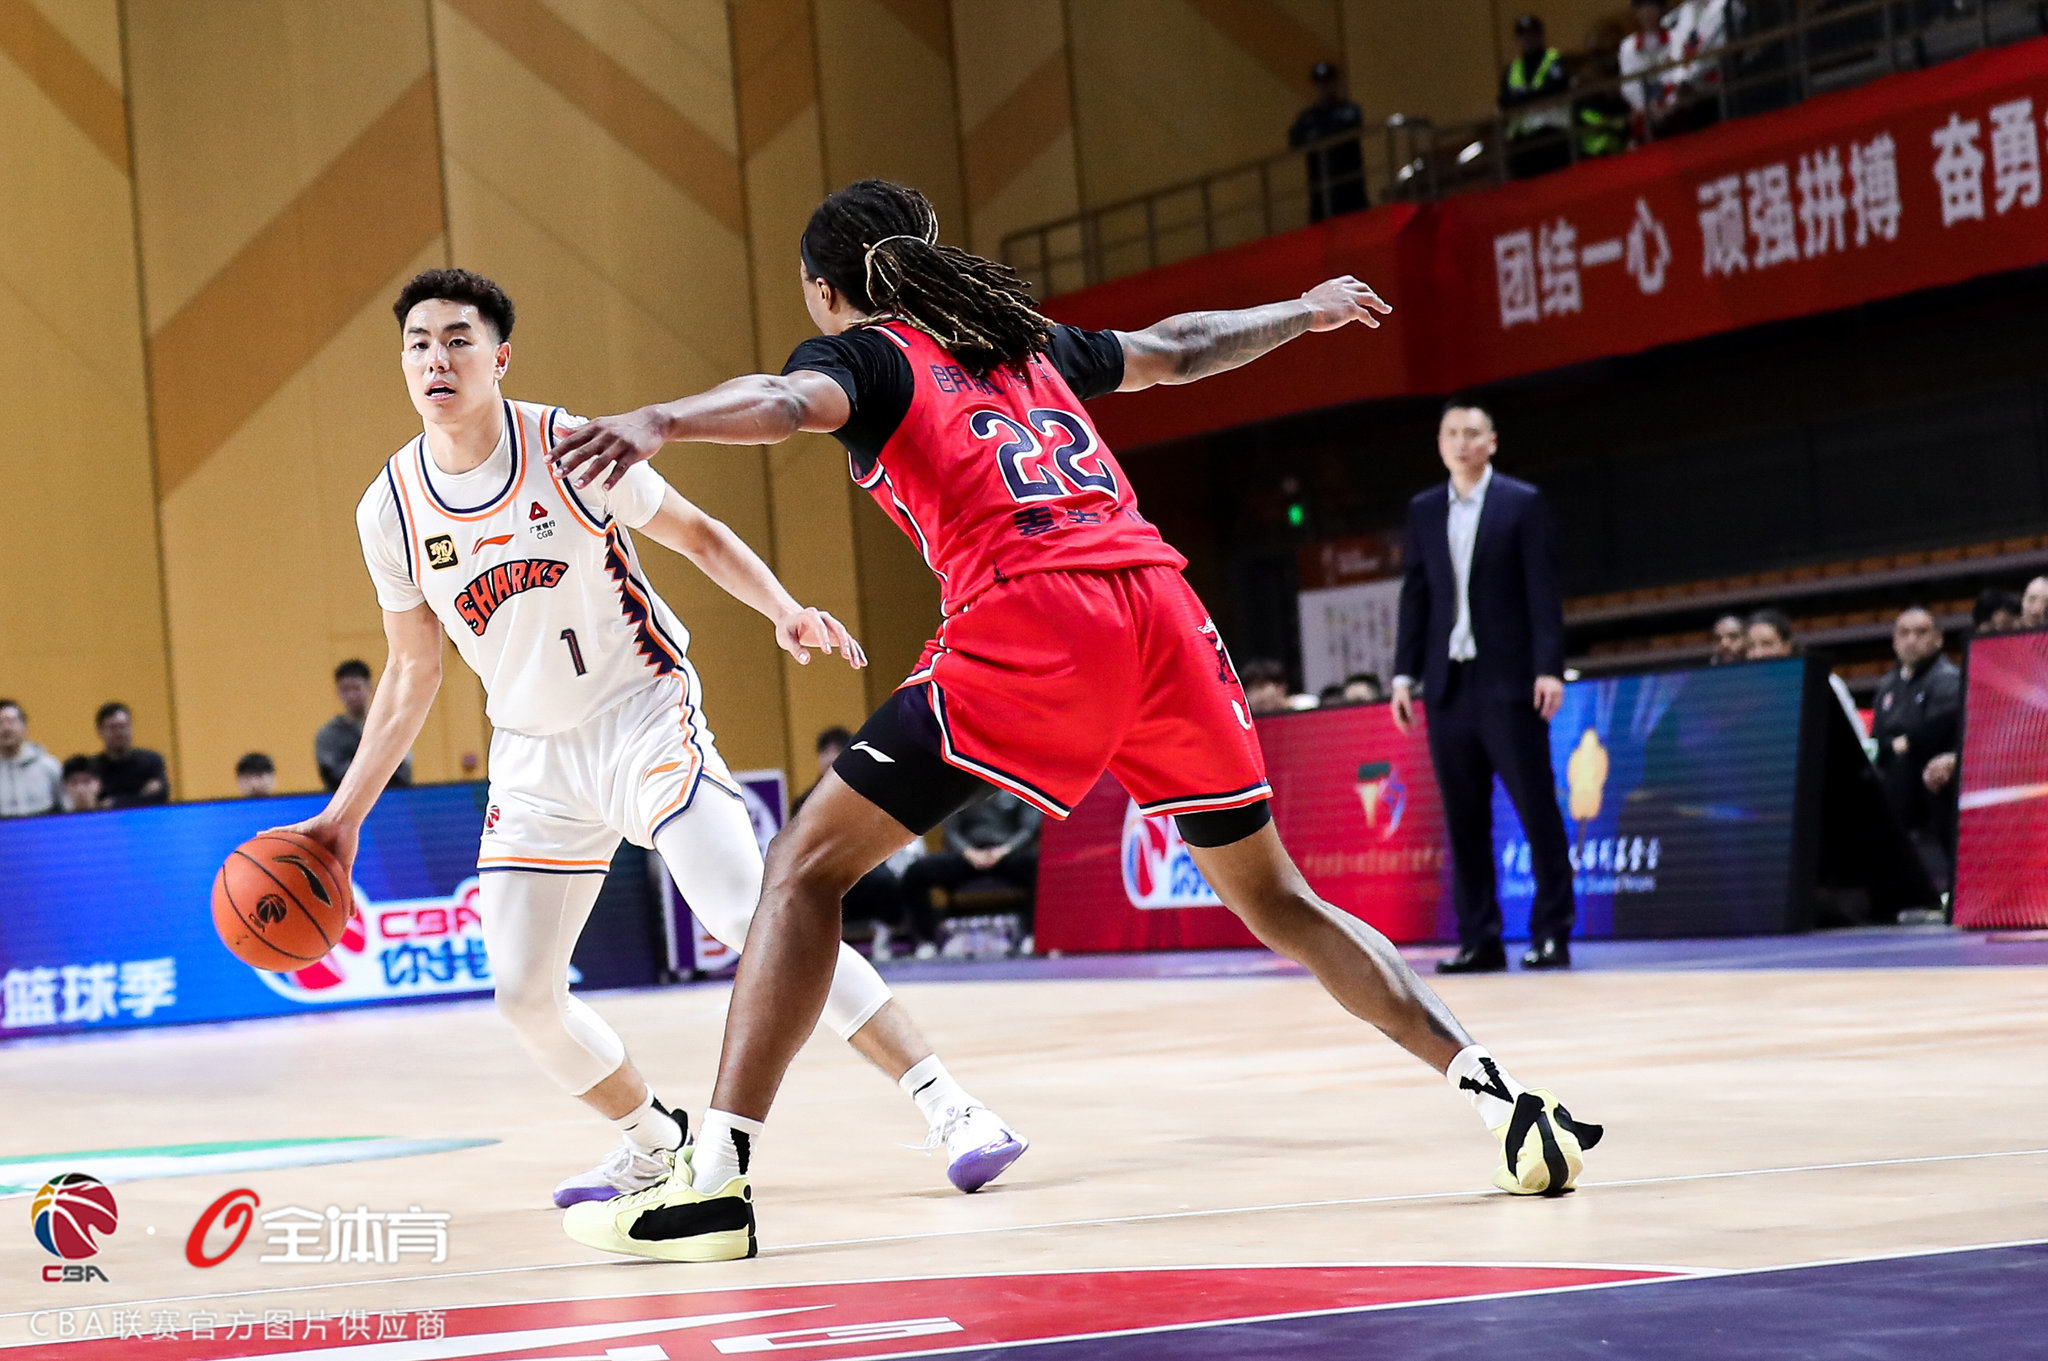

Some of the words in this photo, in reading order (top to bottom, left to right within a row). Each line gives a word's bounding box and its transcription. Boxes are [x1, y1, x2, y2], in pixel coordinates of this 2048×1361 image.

[1494, 198, 1671, 329] 团结一心
[1697, 132, 1901, 278] 顽强拼搏
[1931, 97, 2048, 227] 奋勇
[970, 408, 1118, 503] 22
[537, 529, 553, 540] CGB
[454, 558, 569, 636] SHARKS
[560, 628, 587, 677] 1
[379, 907, 482, 940] CBA
[1, 956, 177, 1028] 篮球季
